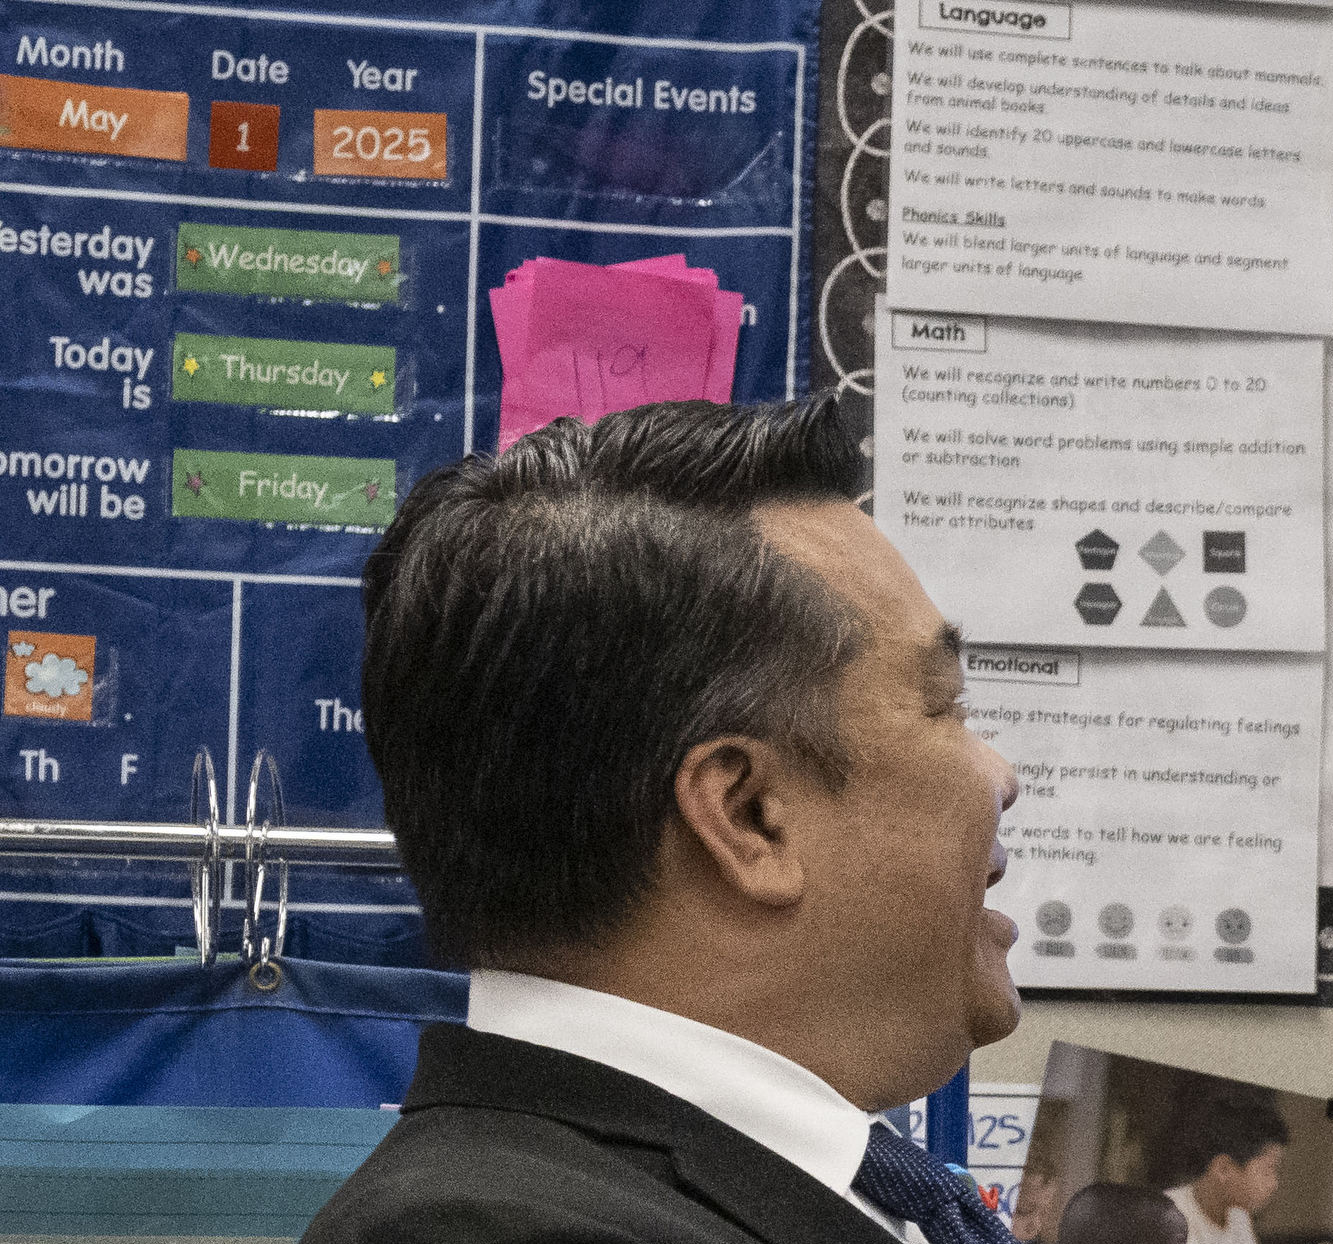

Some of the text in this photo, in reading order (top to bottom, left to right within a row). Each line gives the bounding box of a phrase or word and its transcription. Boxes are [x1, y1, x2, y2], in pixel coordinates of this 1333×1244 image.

[939, 2, 1046, 30] Language
[17, 35, 418, 92] Month Date Year
[527, 71, 757, 114] Special Events
[59, 99, 128, 141] May
[237, 122, 251, 153] 1
[332, 126, 432, 162] 2025
[0, 225, 154, 269] esterday
[209, 243, 369, 281] Wednesday
[78, 269, 153, 298] was
[911, 322, 966, 341] Math
[50, 336, 154, 380] Today
[219, 353, 350, 394] Thursday
[122, 377, 151, 410] is
[903, 364, 929, 381] We
[935, 367, 962, 383] will
[967, 371, 1045, 388] recognize
[1050, 373, 1078, 388] and
[1084, 374, 1126, 388] write
[1132, 376, 1200, 392] numbers
[1223, 377, 1240, 391] to
[1246, 376, 1267, 392] 20
[901, 384, 1076, 409] (counting collections)
[903, 427, 1053, 448] We will solve word
[27, 482, 146, 520] will be
[238, 470, 328, 507] Friday
[967, 655, 1059, 676] Emotional
[20, 748, 60, 783] Th
[121, 753, 139, 785] F
